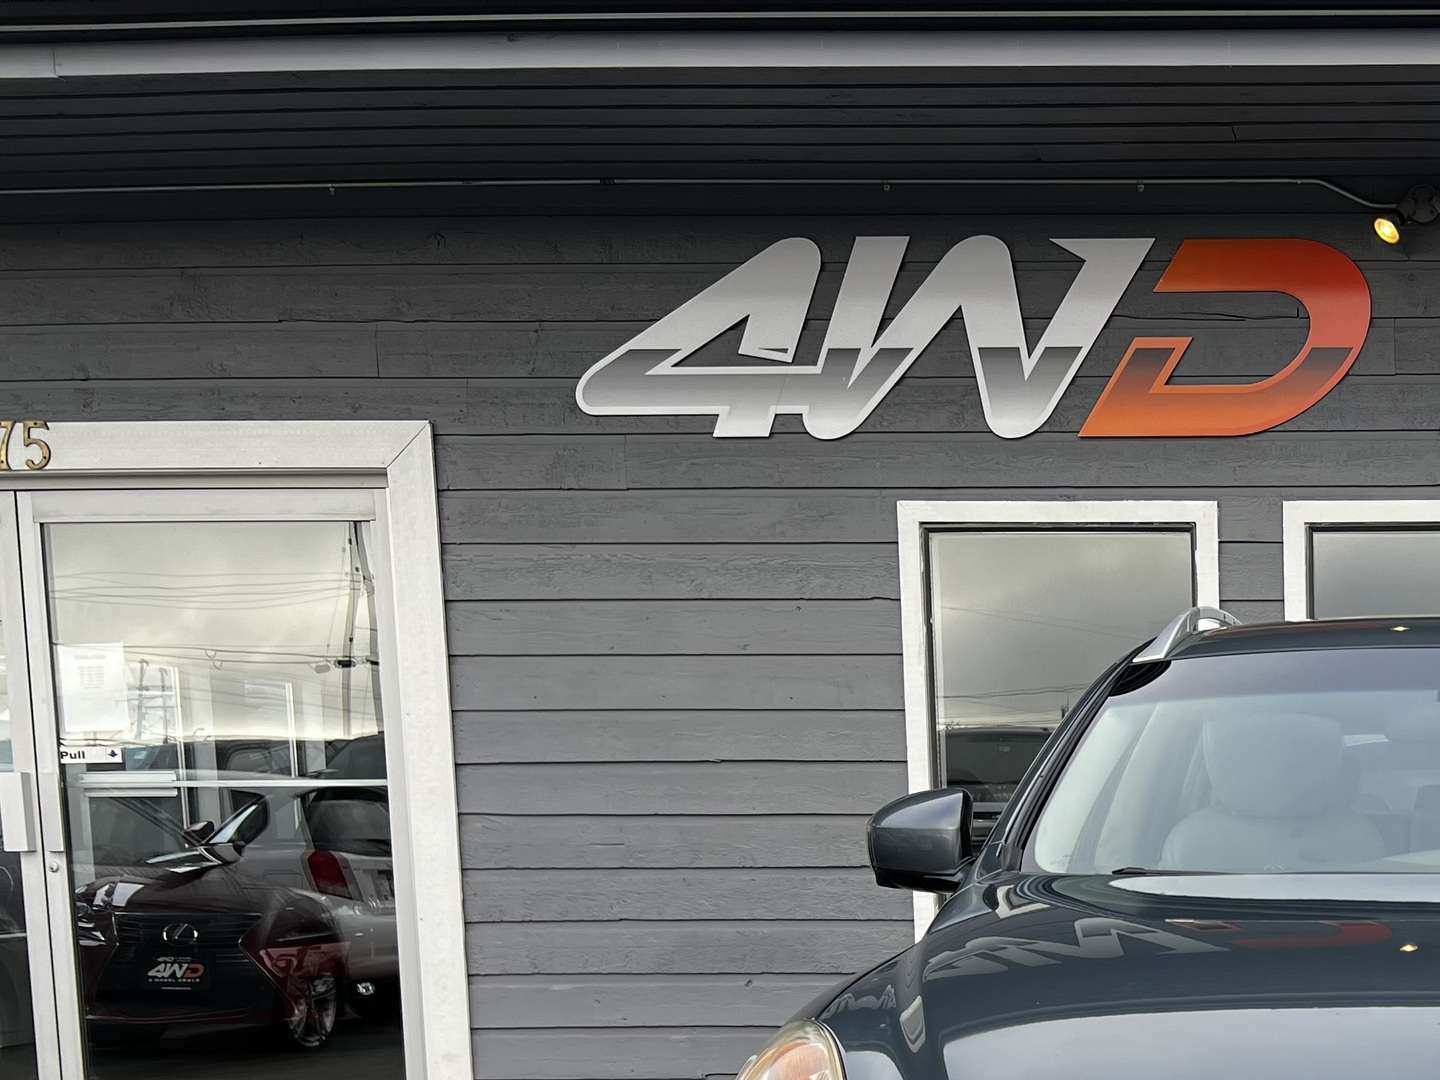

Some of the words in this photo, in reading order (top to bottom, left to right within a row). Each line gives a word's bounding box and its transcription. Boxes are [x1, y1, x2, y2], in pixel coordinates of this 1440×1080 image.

[576, 235, 1372, 439] 4WD
[60, 751, 86, 760] Pull
[147, 963, 205, 978] 4WD
